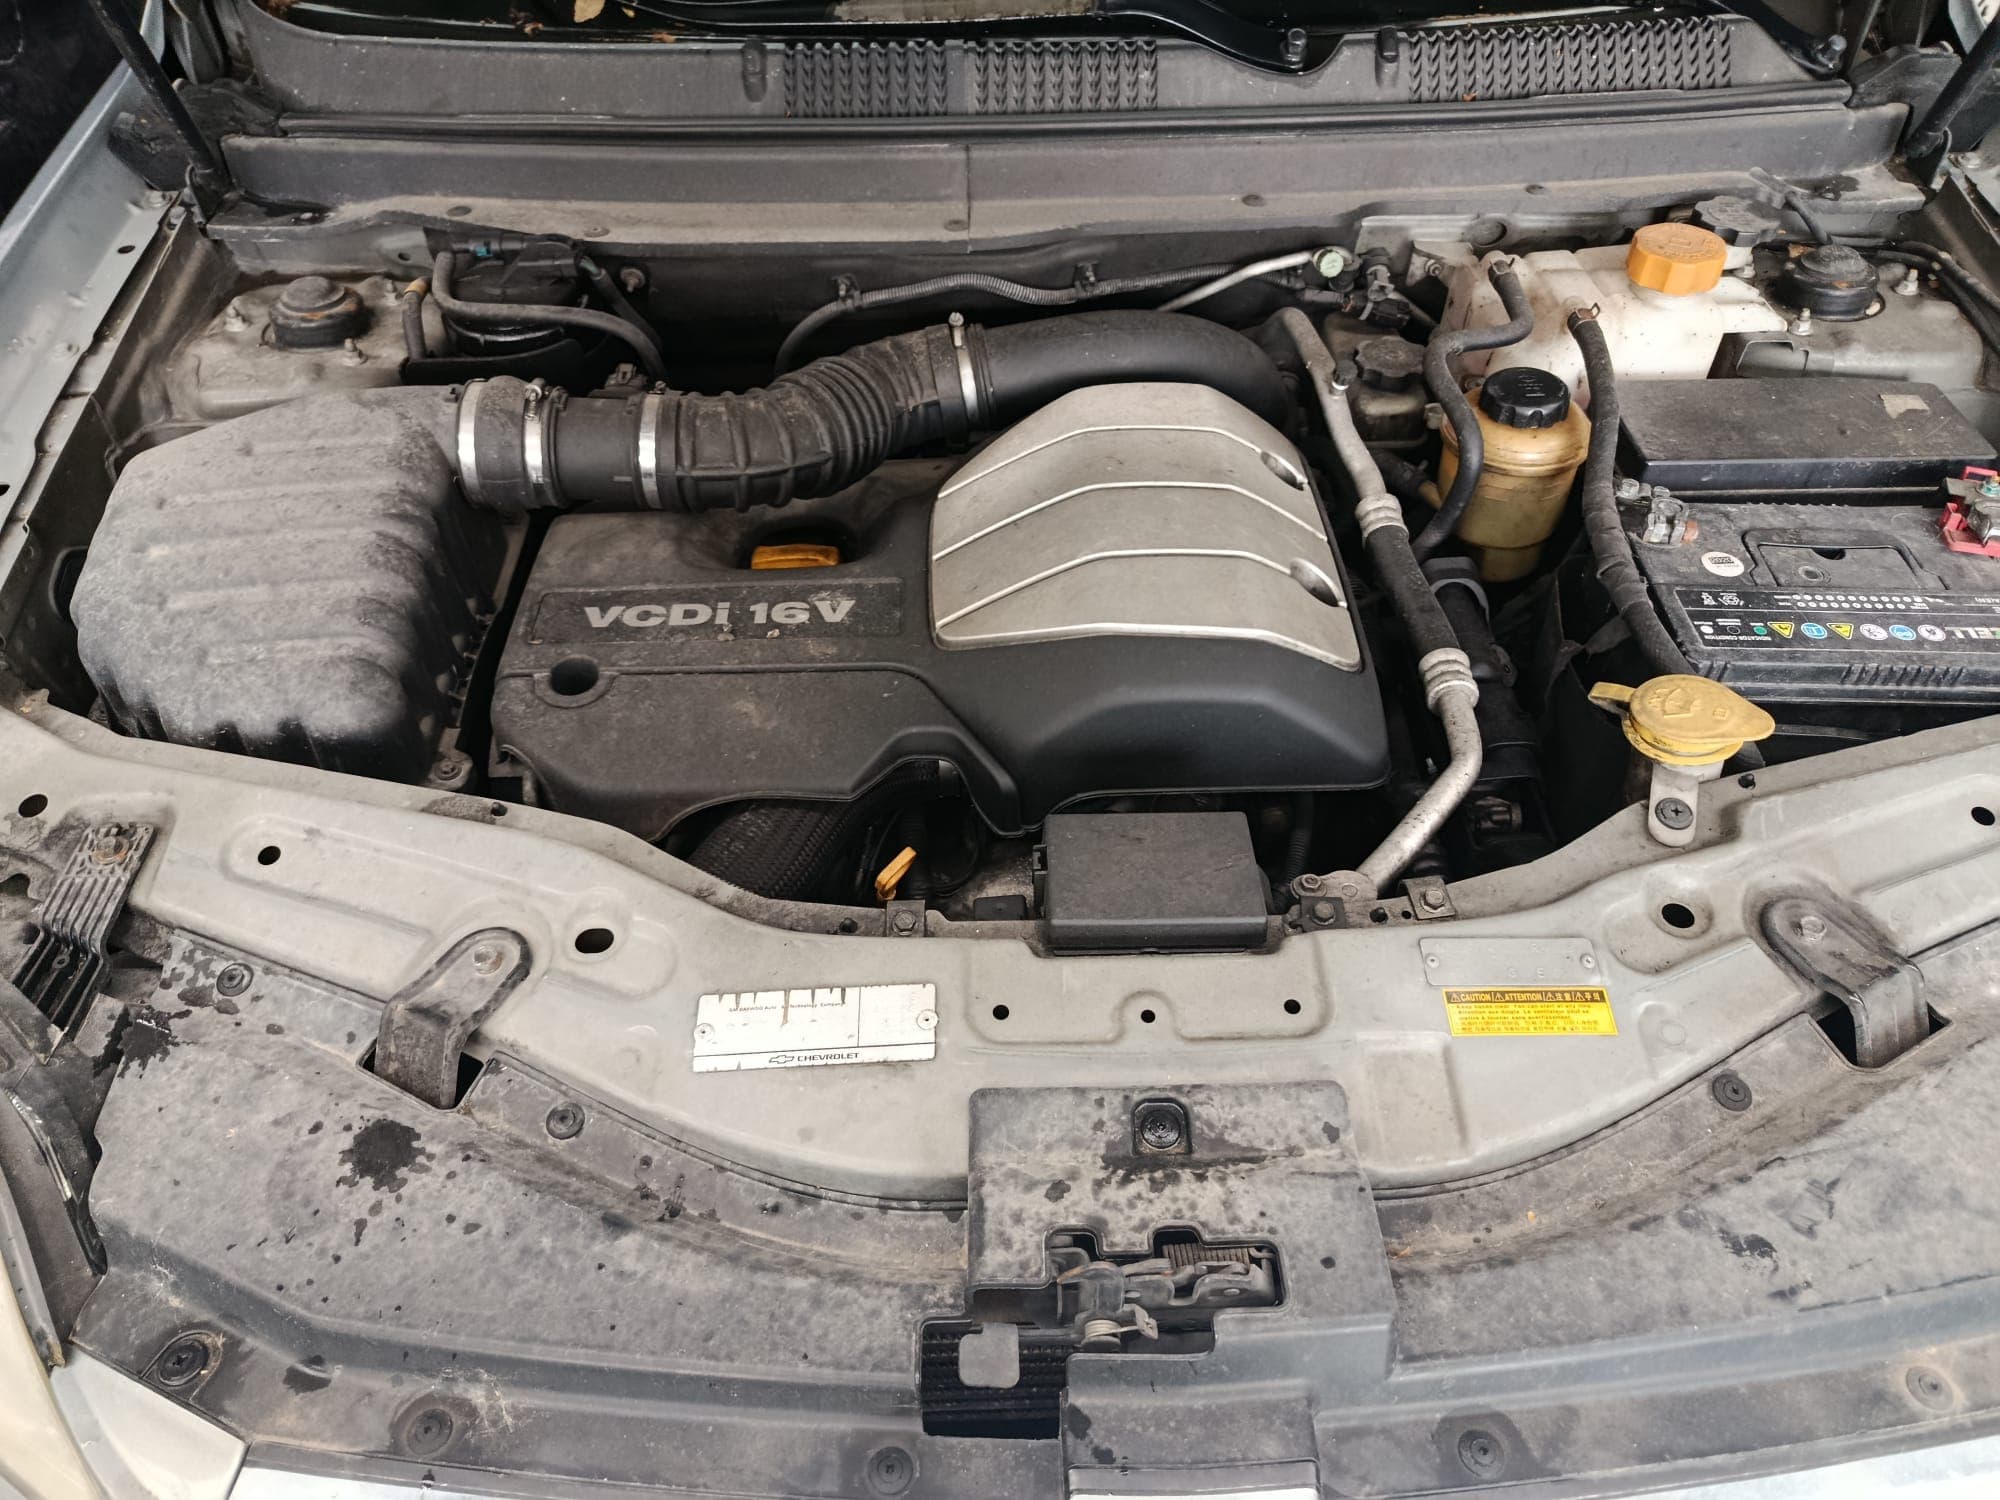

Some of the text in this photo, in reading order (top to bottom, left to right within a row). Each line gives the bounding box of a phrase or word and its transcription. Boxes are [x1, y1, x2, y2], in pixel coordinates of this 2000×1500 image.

[584, 600, 856, 628] VCDi 16V
[1460, 991, 1543, 1001] CAUTION ATTENTION
[797, 1052, 860, 1062] CHEVROLET
